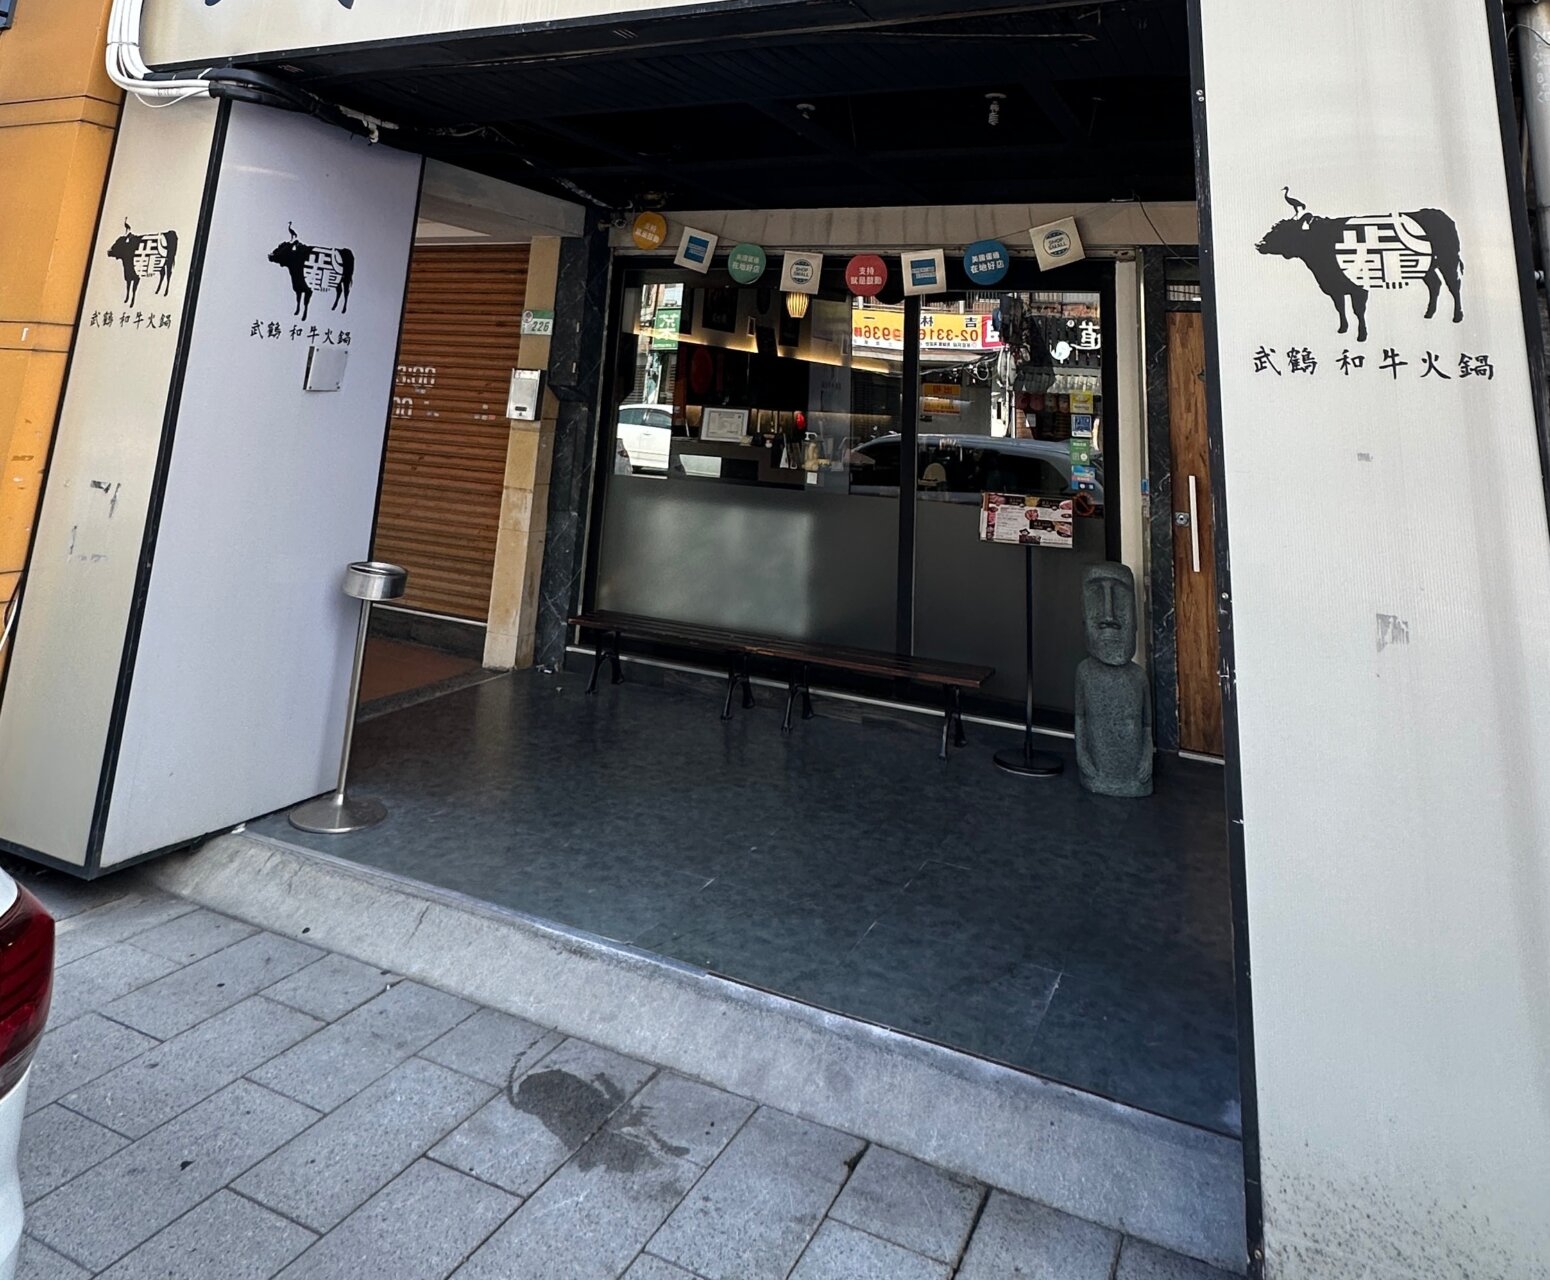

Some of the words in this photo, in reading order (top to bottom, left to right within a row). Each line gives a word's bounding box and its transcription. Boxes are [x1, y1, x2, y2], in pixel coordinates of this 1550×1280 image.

[119, 311, 172, 330] 和牛火鍋
[250, 318, 282, 340] 武鶴
[289, 323, 351, 346] 和牛火鍋
[531, 321, 550, 332] 226
[1252, 346, 1317, 377] 武鶴
[1335, 347, 1494, 380] 和牛火鍋
